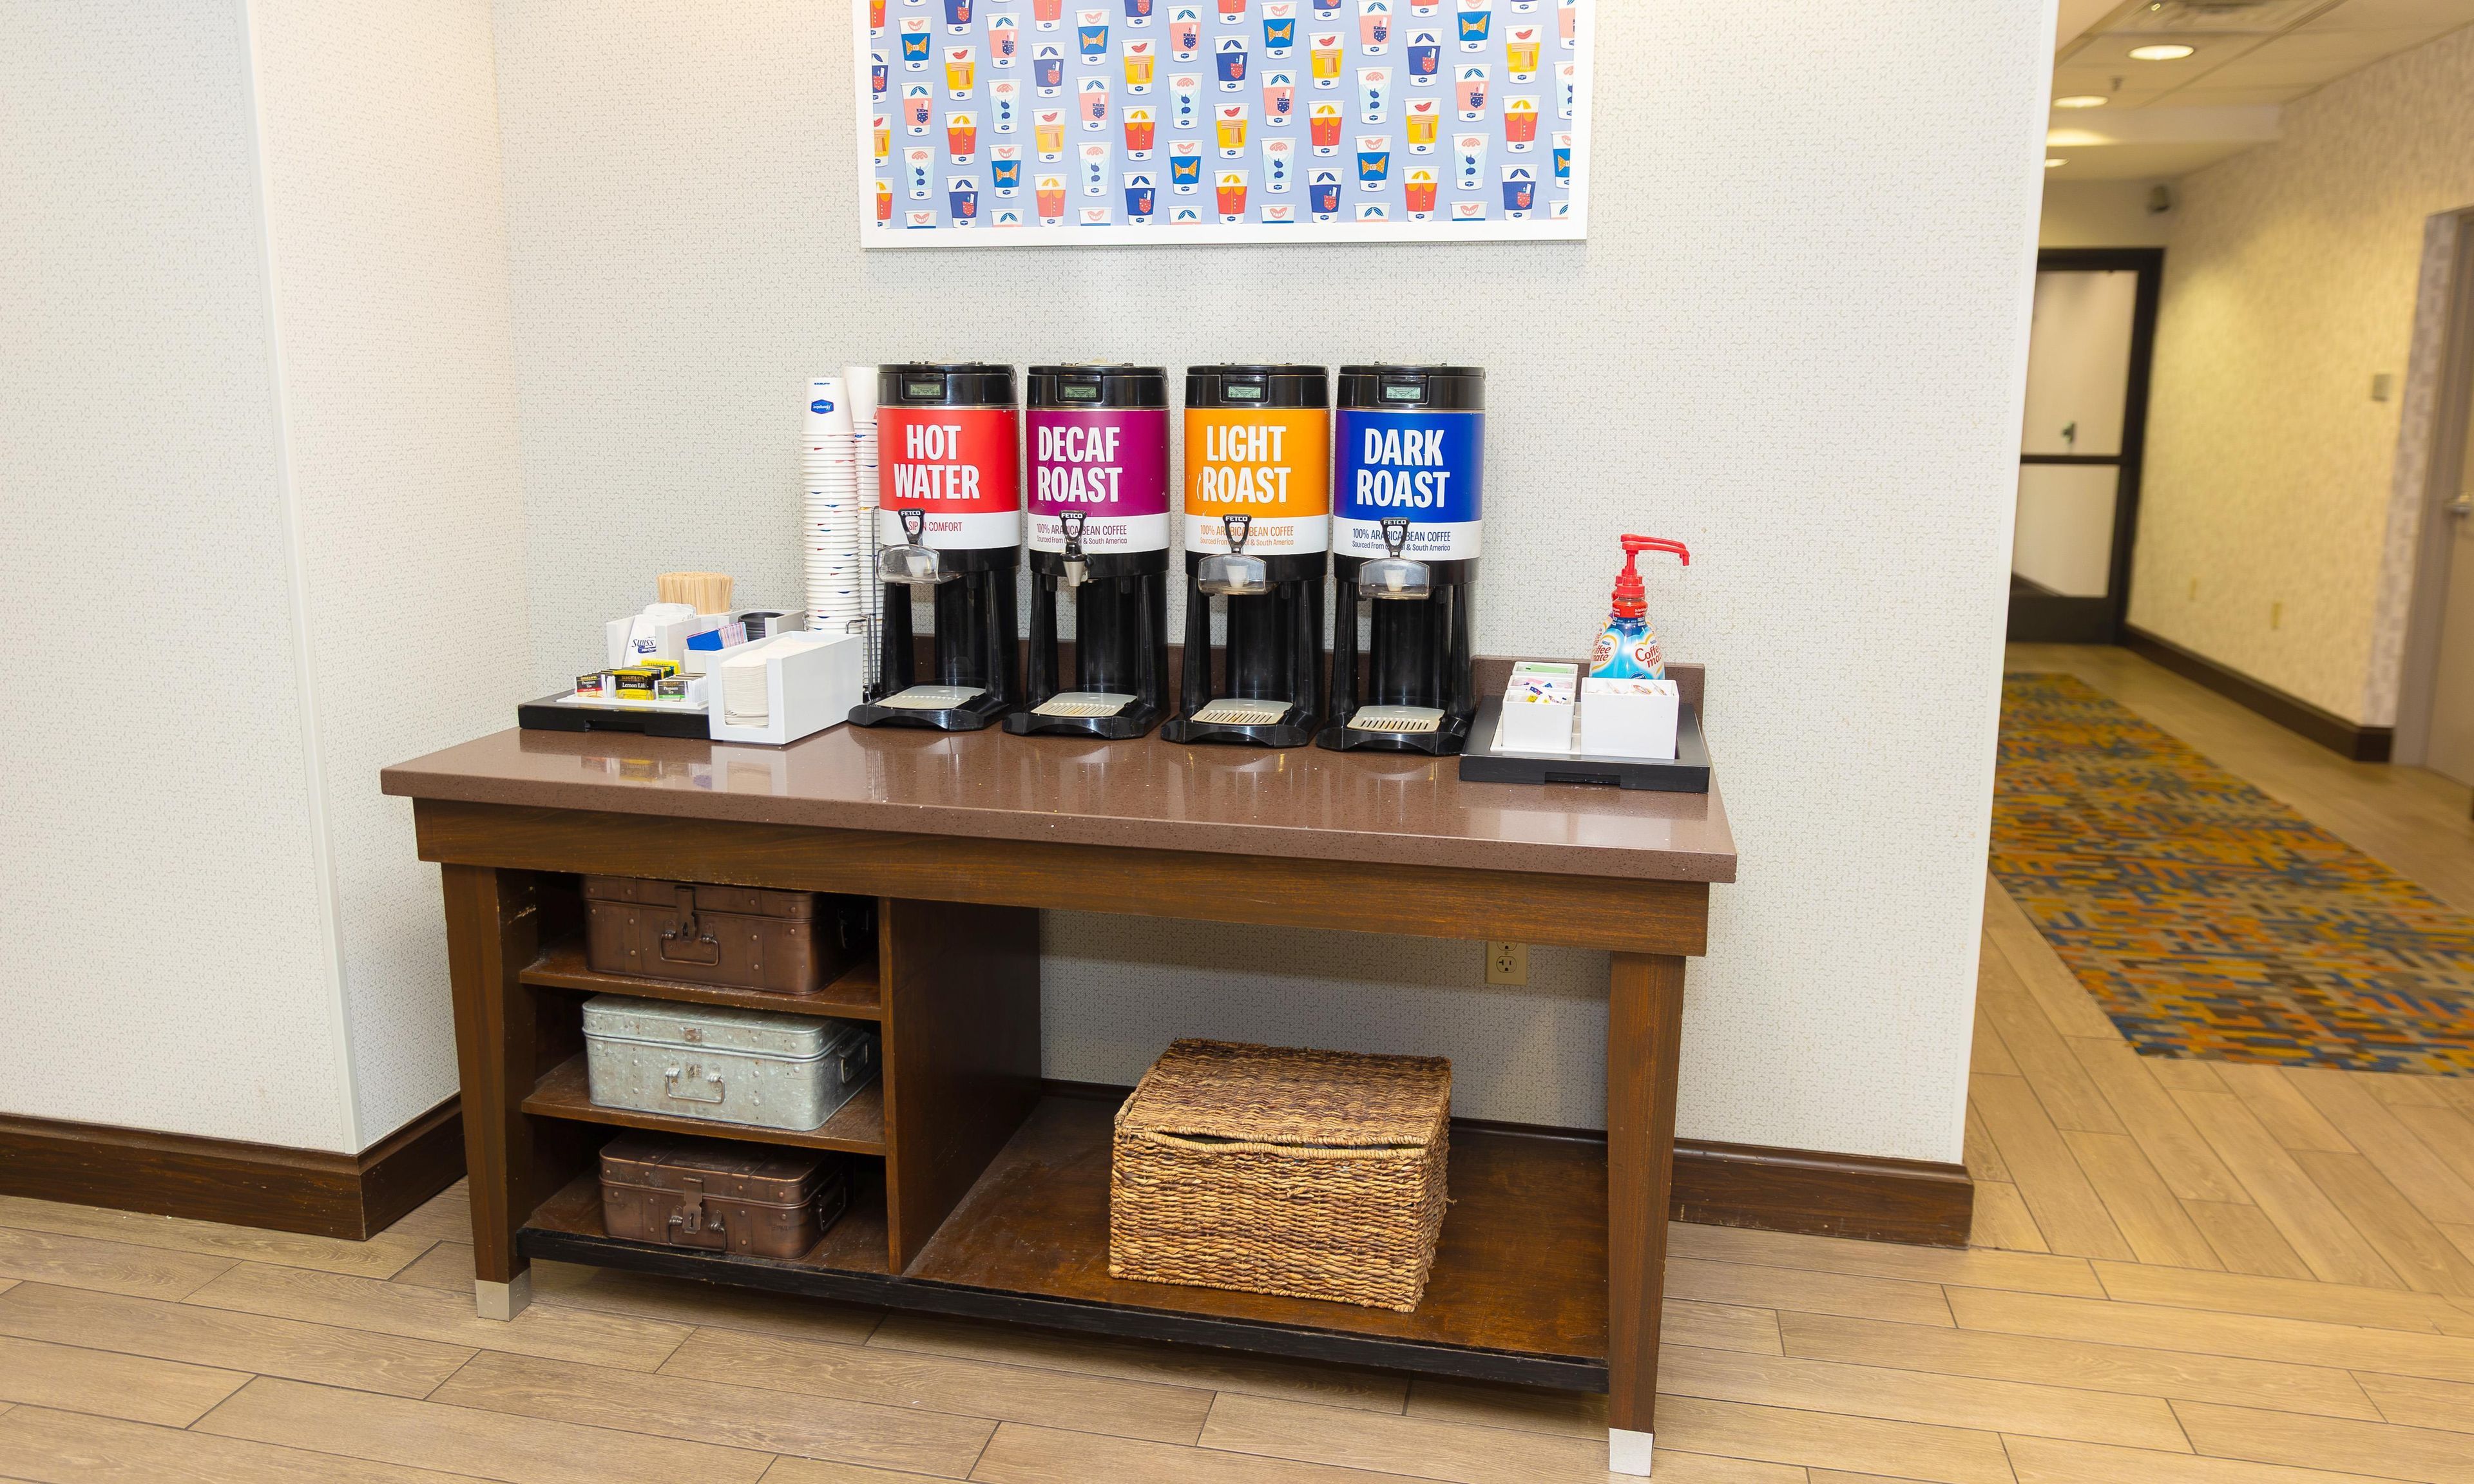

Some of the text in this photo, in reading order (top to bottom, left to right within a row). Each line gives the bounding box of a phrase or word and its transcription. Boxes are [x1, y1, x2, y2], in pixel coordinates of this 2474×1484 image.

[906, 424, 961, 460] HOT
[1039, 426, 1120, 462] DECAF
[1207, 425, 1287, 462] LIGHT
[1364, 428, 1444, 466] DARK
[894, 463, 980, 499] WATER
[1037, 466, 1123, 503] ROAST
[1203, 466, 1291, 503] ROAST
[1356, 469, 1450, 508] ROAST
[908, 520, 919, 531] SIP
[928, 522, 963, 532] COMFORT
[1037, 523, 1127, 537] 100% ARAICA BEAN COFFEE
[1037, 535, 1051, 544] Sourced
[1200, 525, 1215, 535] 100%
[1249, 526, 1269, 537] BEAN
[1271, 526, 1294, 536] COFFEE
[1353, 528, 1370, 540] 100%
[1406, 531, 1425, 542] BEAN
[1427, 531, 1451, 542] COFFEE
[1429, 543, 1451, 551] America
